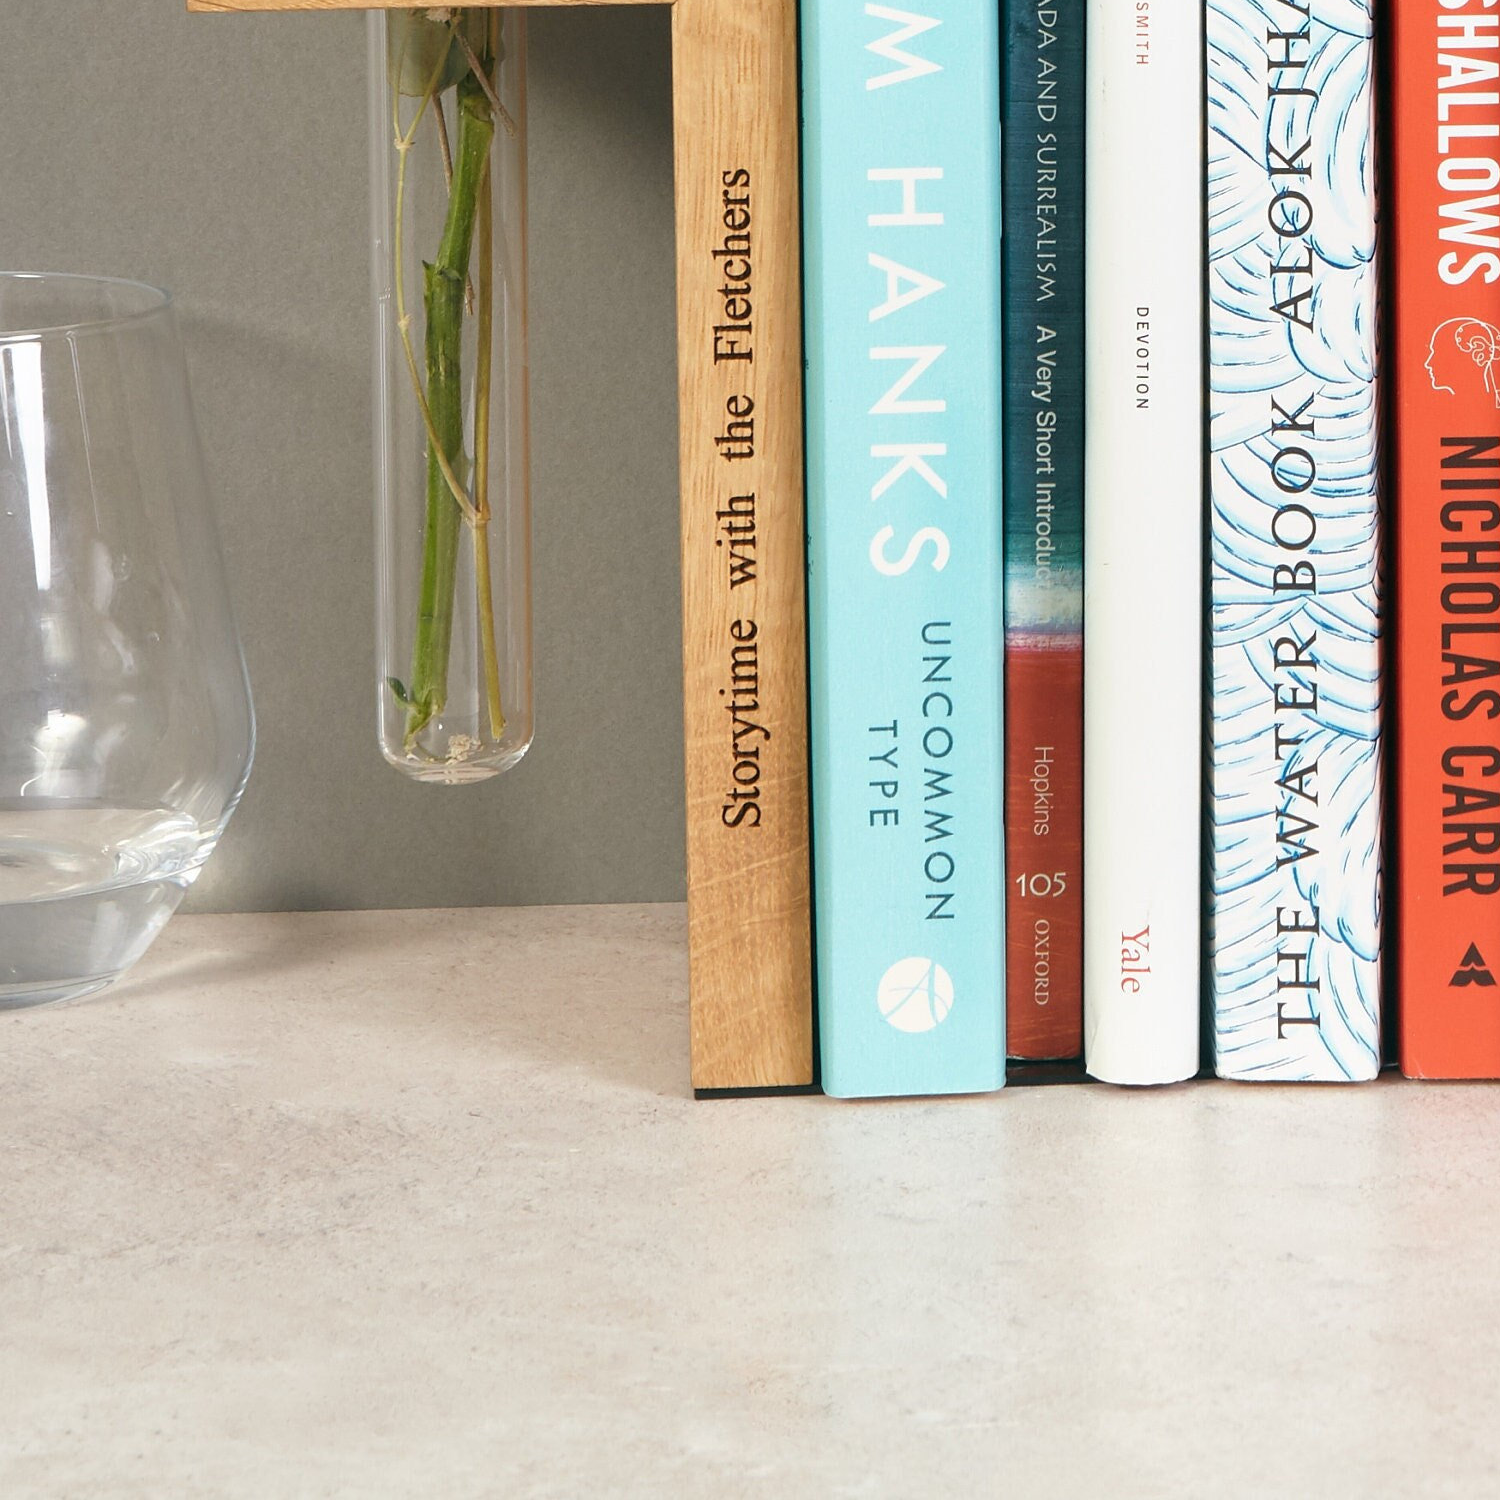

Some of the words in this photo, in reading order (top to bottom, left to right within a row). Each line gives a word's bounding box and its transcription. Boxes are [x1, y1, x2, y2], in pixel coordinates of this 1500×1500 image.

[1136, 1, 1149, 66] SMITH
[1036, 58, 1057, 123] AND
[712, 168, 754, 366] Fletchers
[1036, 133, 1057, 302] SURREALISM
[1267, 136, 1315, 334] ALOK
[867, 166, 951, 577] HANKS
[1031, 347, 1057, 404] Very
[1036, 325, 1057, 344] A
[1136, 306, 1150, 410] DEVOTION
[714, 393, 756, 462] the
[1035, 410, 1057, 476] Short
[715, 492, 758, 590] with
[1271, 391, 1319, 596] BOOK
[719, 618, 771, 829] Storytime
[868, 719, 899, 828] TYPE
[921, 621, 956, 921] UNCOMMON
[1274, 630, 1320, 872] WATER
[1034, 746, 1055, 836] Hopkins
[1014, 872, 1066, 898] 105
[1034, 918, 1050, 1006] OXFORD
[1120, 924, 1151, 994] Yale
[1276, 903, 1322, 1040] THE
